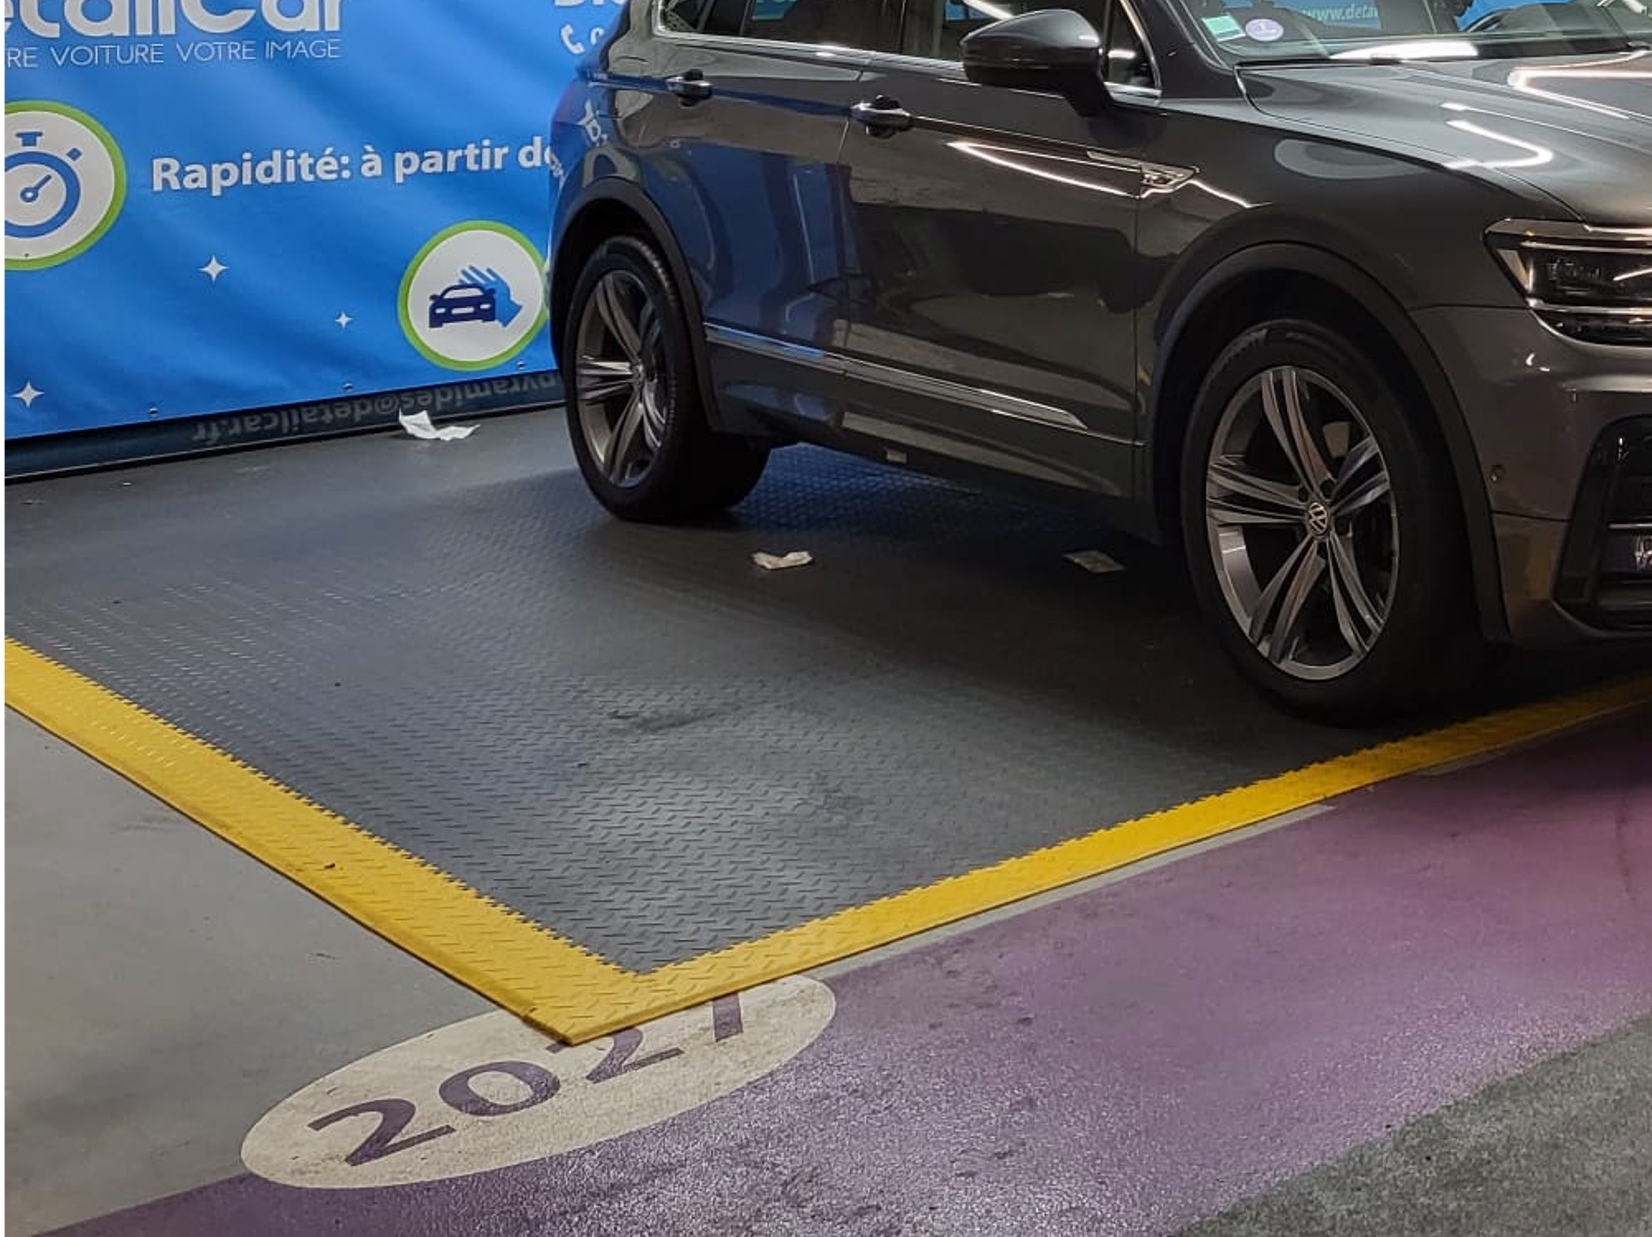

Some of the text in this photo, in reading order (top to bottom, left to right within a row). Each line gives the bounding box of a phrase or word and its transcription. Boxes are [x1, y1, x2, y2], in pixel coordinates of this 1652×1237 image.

[7, 38, 341, 68] RE VOITURE VOTRE IMAGE
[152, 149, 351, 196] Rapidité:
[361, 145, 382, 178] à
[395, 140, 509, 183] partir
